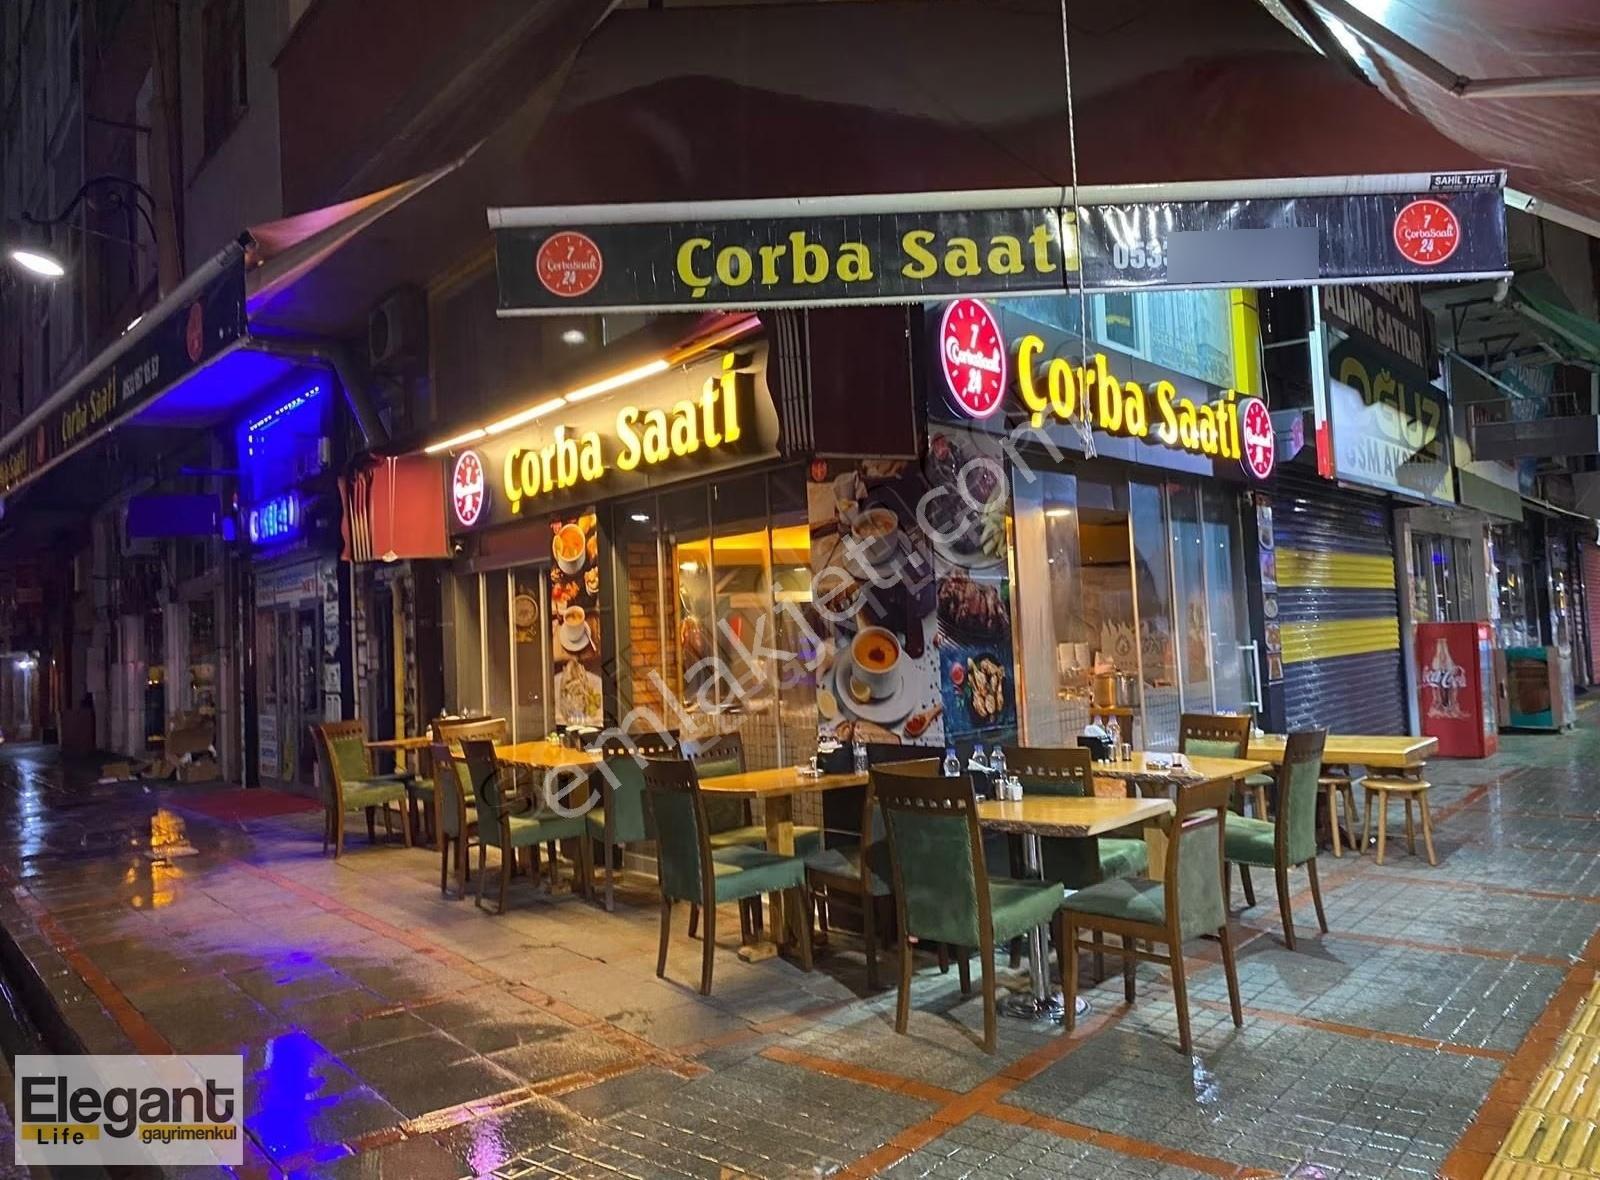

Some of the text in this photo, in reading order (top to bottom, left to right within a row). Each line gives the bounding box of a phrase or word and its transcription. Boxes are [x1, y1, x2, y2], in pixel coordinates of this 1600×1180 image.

[1465, 174, 1496, 184] TENTE
[1423, 214, 1432, 229] 7
[567, 245, 575, 261] 7
[676, 230, 875, 298] Çorba
[902, 211, 1081, 280] Saati
[1420, 239, 1435, 253] 24
[561, 270, 577, 285] 24
[1376, 306, 1425, 368] SATILIR
[1018, 335, 1148, 437] Çorba
[1156, 379, 1242, 460] Saati
[1340, 357, 1441, 448] OĞUZ
[503, 424, 605, 514] Çorba
[615, 352, 741, 471] Saati
